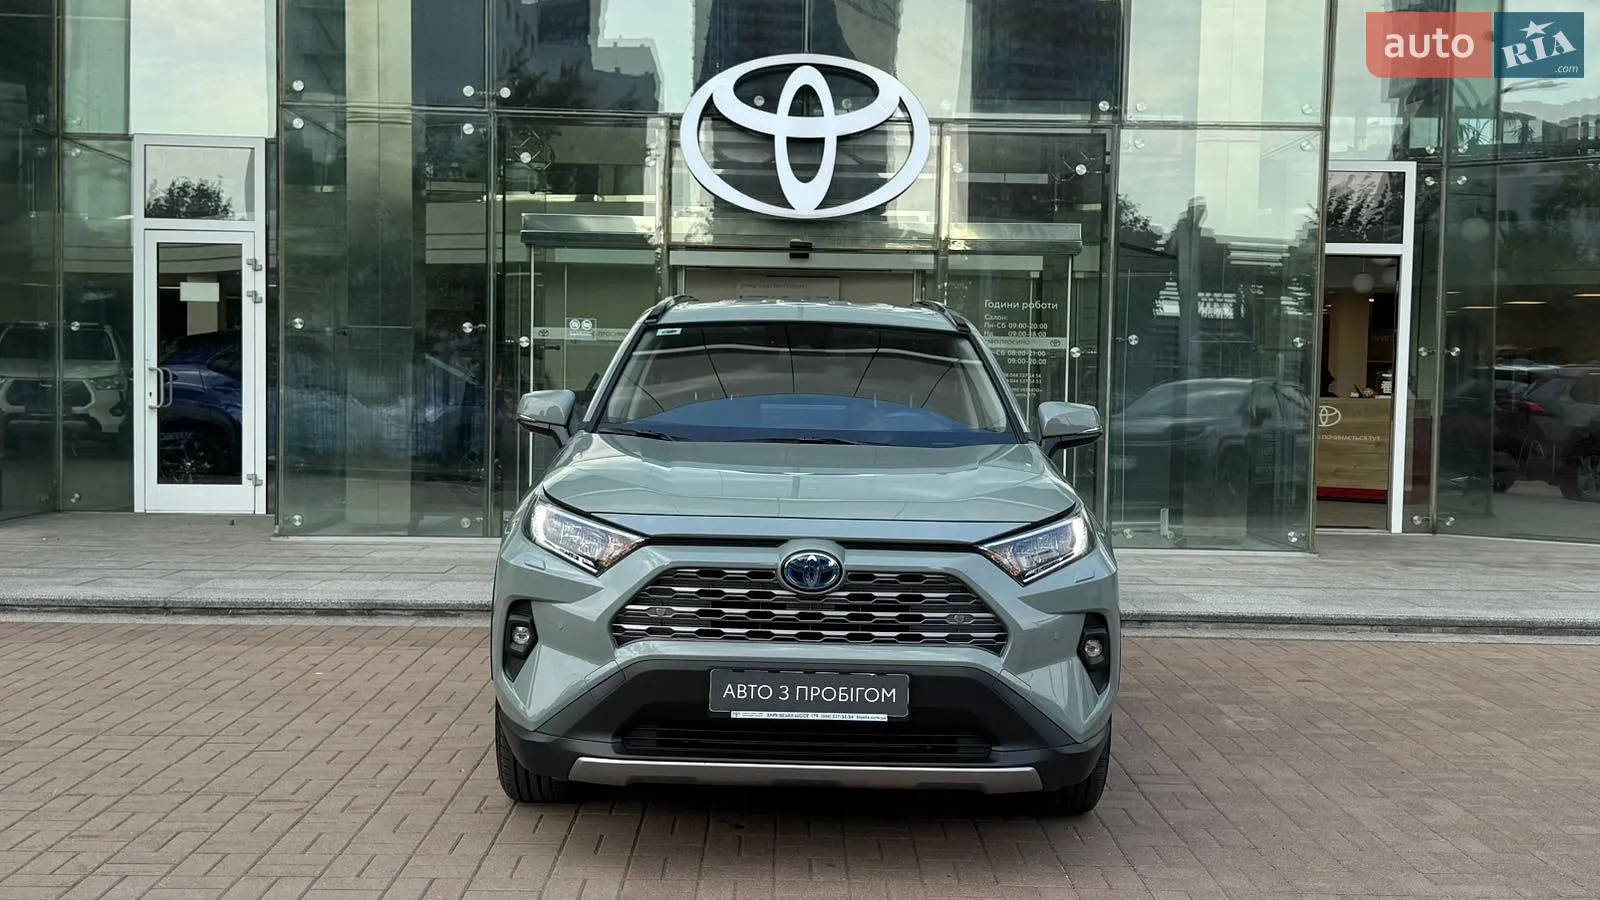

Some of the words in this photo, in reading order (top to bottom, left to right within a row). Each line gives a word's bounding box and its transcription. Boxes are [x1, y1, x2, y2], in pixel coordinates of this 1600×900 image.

[984, 300, 1020, 310] Години
[1021, 300, 1058, 311] роботи
[723, 683, 773, 700] АВТО
[779, 685, 789, 701] З
[796, 685, 897, 703] ПРОБІГОМ
